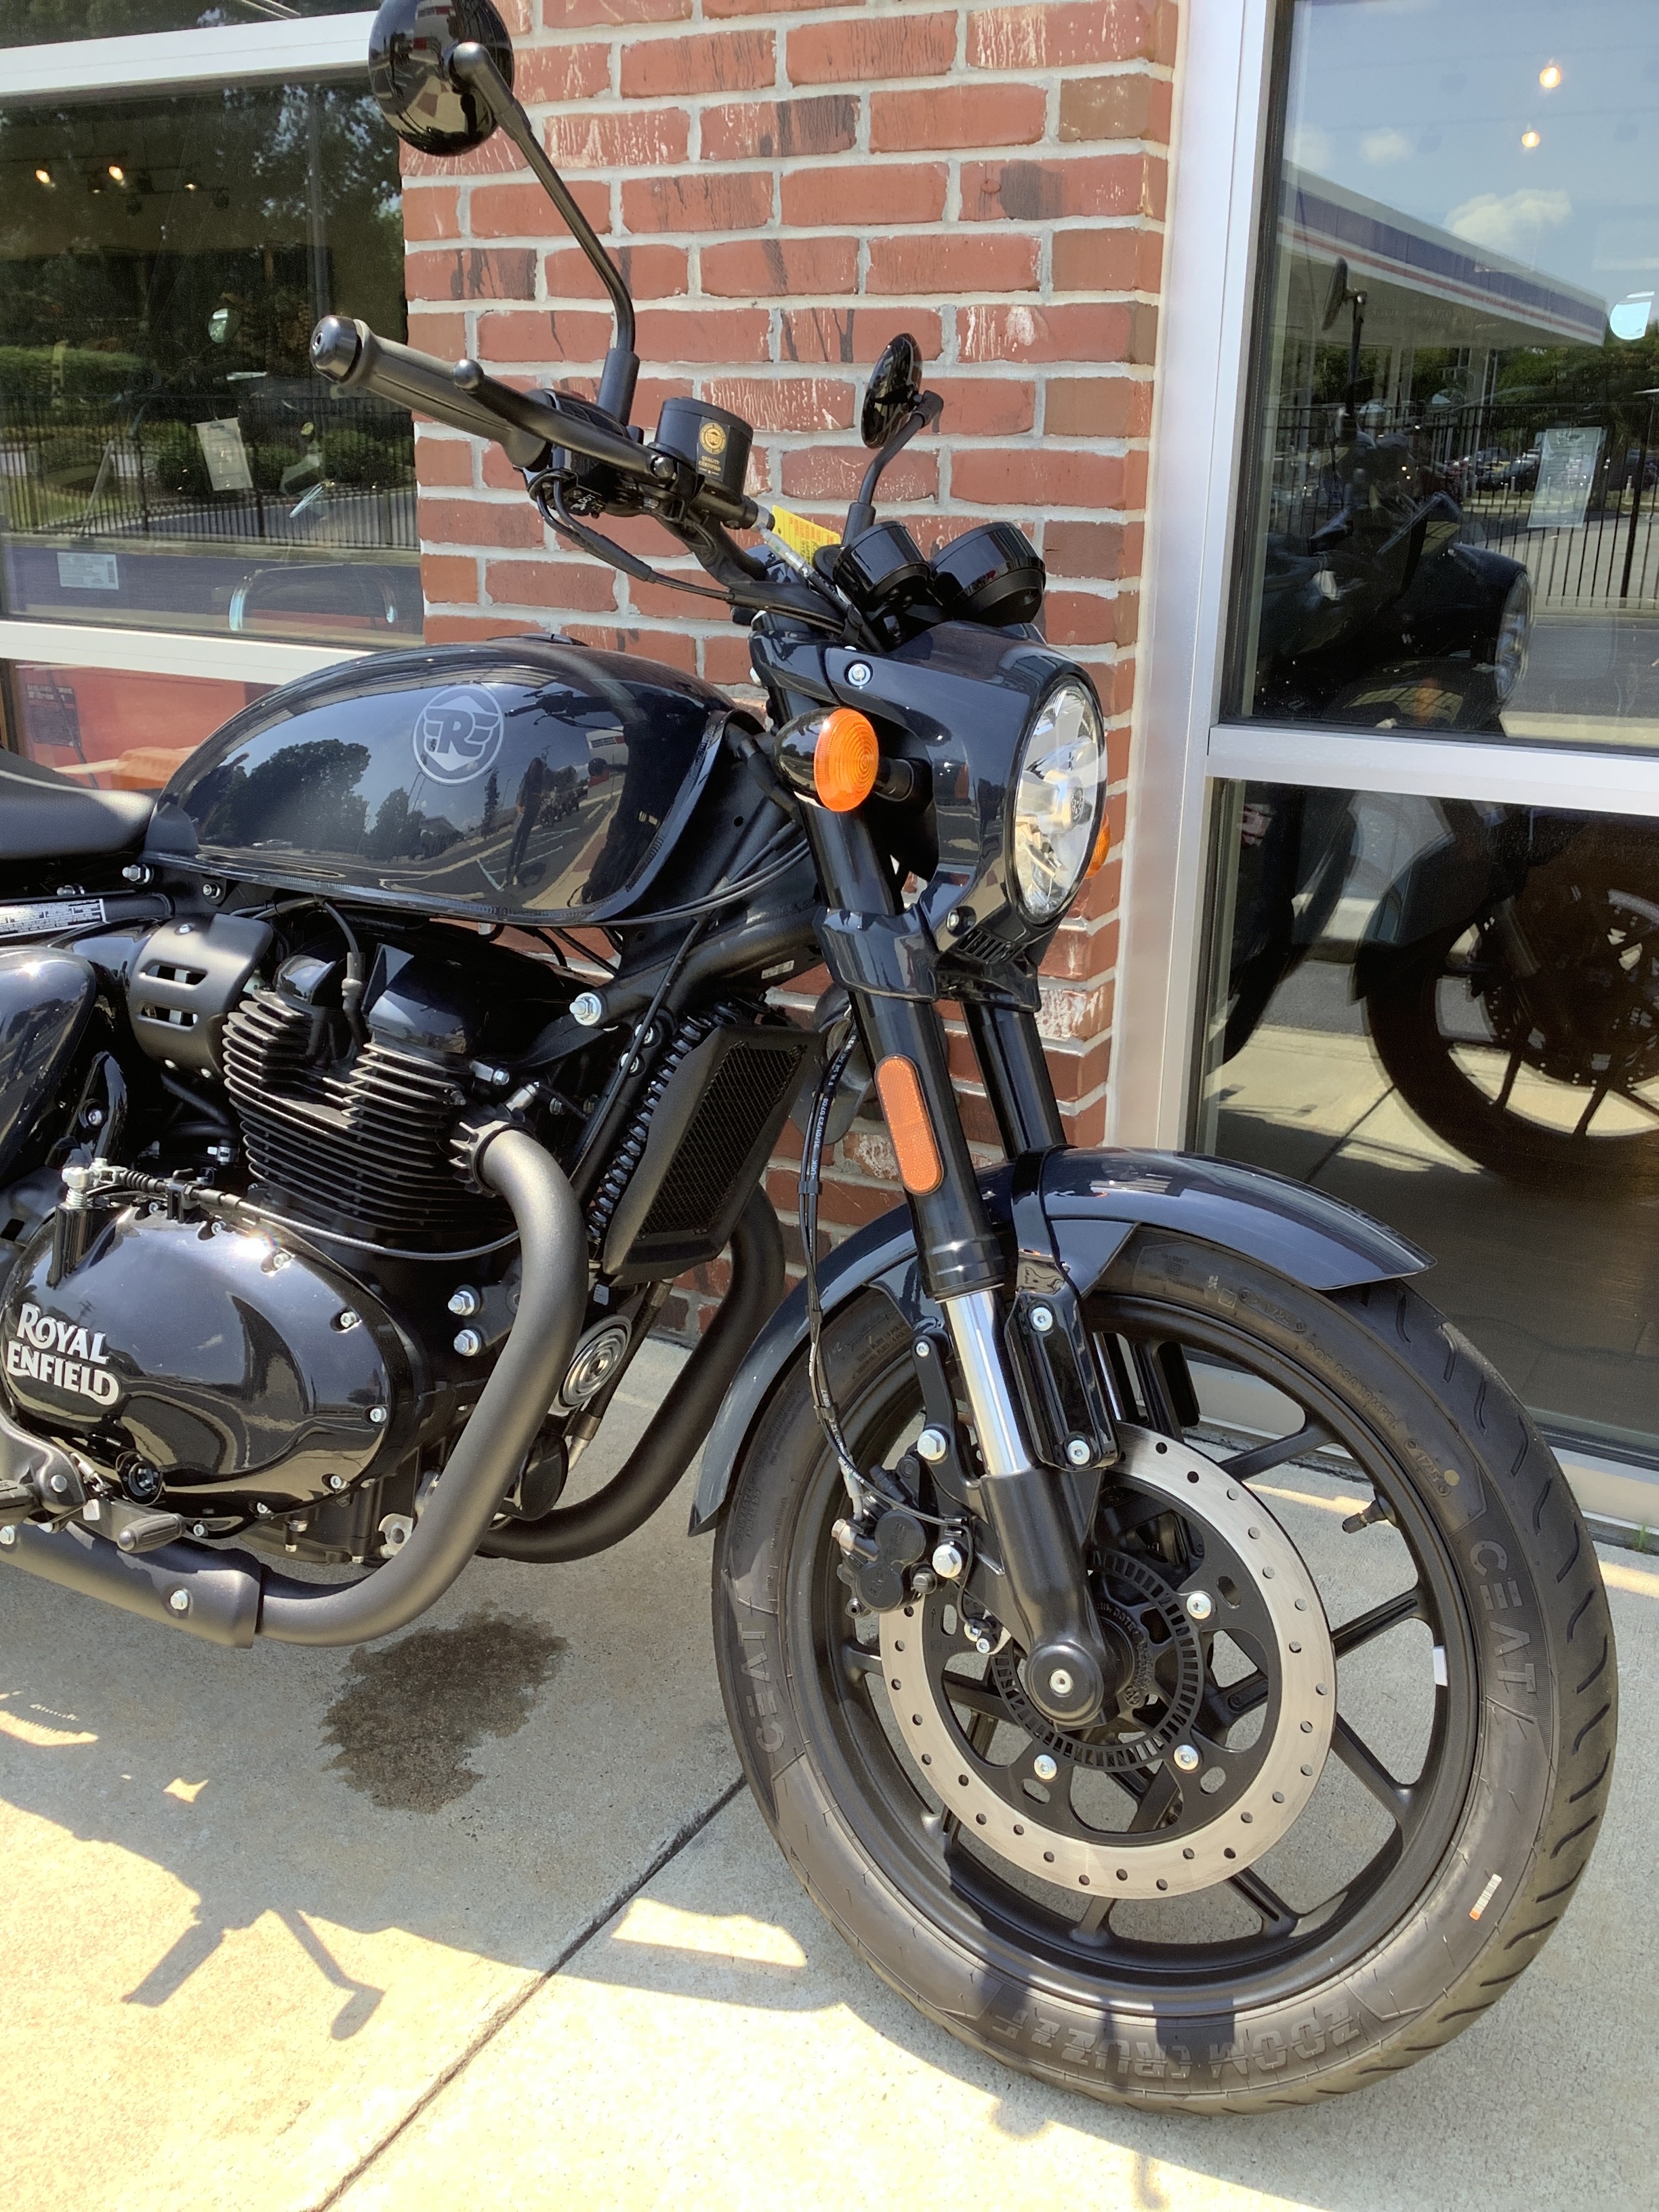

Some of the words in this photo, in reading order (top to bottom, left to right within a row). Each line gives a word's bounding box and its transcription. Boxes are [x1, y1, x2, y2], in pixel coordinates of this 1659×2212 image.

[16, 1302, 110, 1365] ROYAL
[1305, 1341, 1334, 1366] DOT
[7, 1340, 119, 1406] ENFIELD
[1470, 1540, 1536, 1694] CEAT
[737, 1622, 785, 1754] CEAT
[1208, 2001, 1361, 2078] ZOOM
